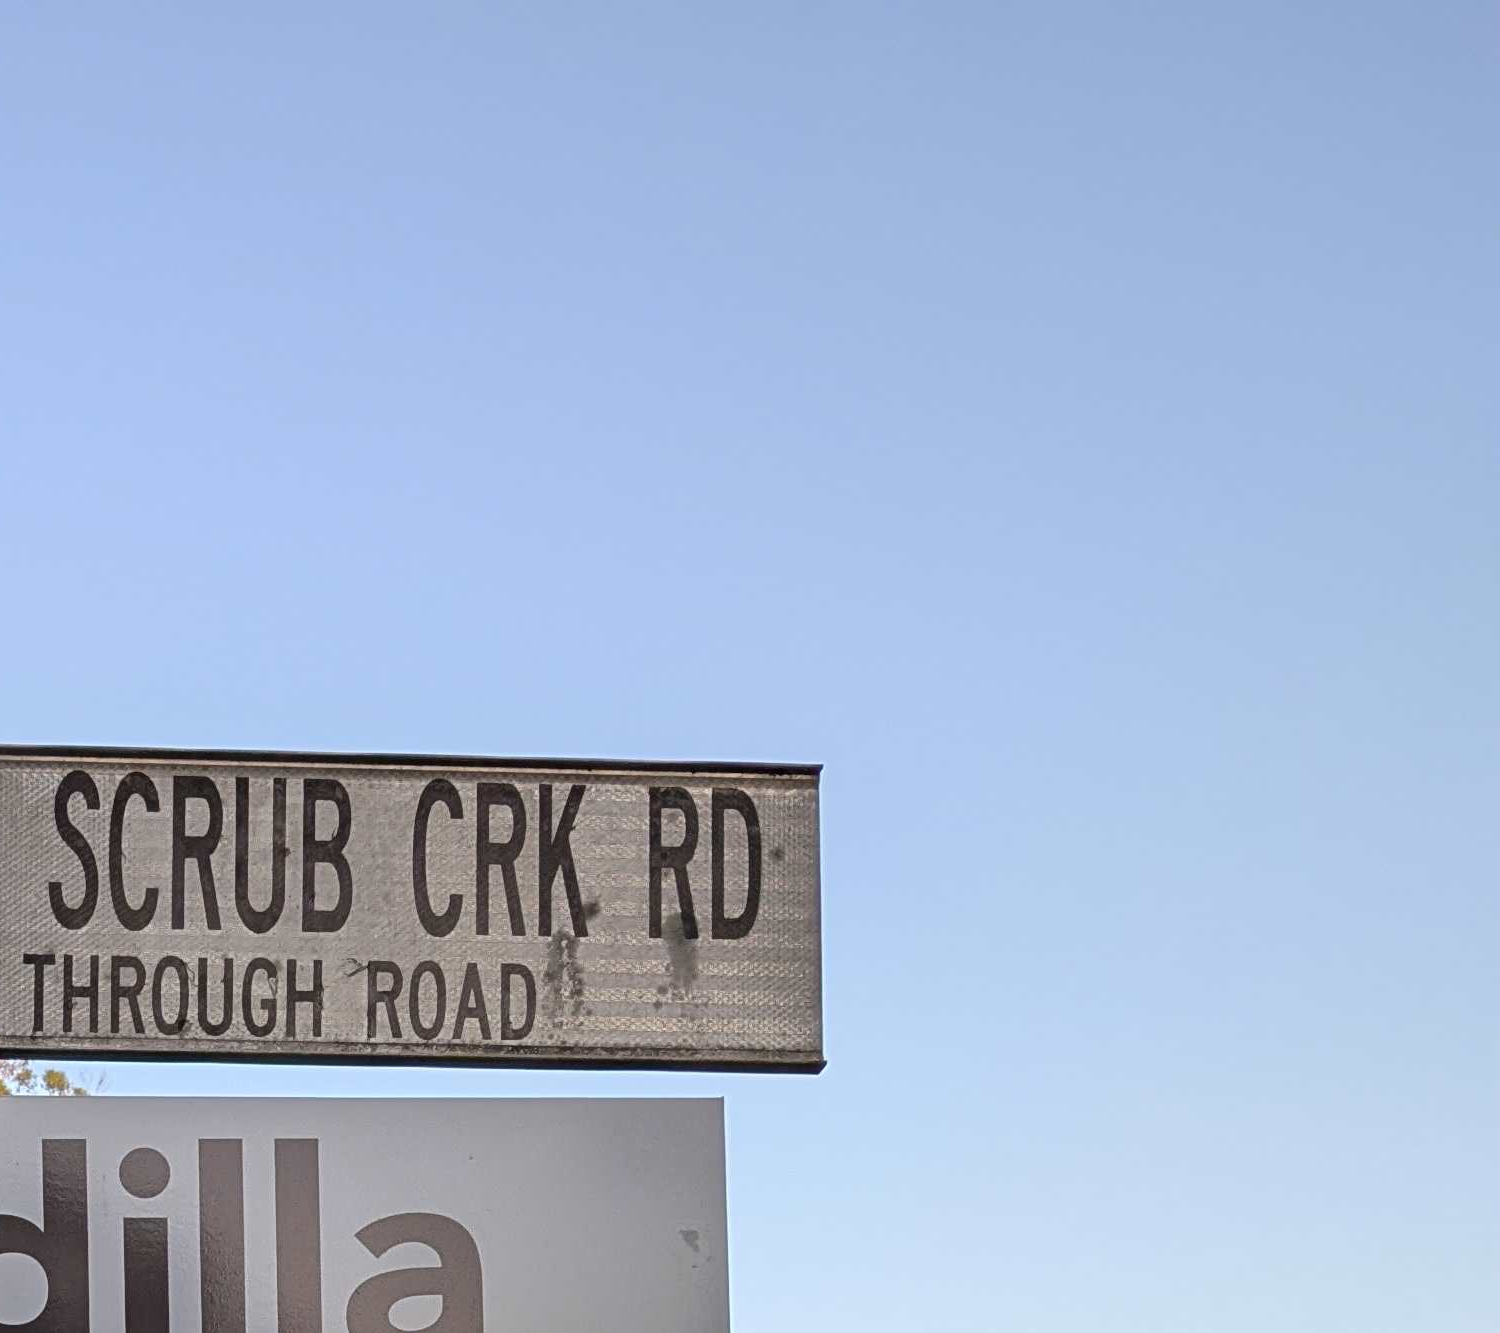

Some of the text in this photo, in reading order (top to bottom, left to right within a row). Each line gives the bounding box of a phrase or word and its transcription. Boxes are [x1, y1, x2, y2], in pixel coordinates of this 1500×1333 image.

[48, 769, 354, 934] SCRUB
[412, 777, 589, 939] CRK
[648, 785, 763, 941] RD
[23, 953, 324, 1039] THROUGH
[366, 960, 537, 1042] ROAD
